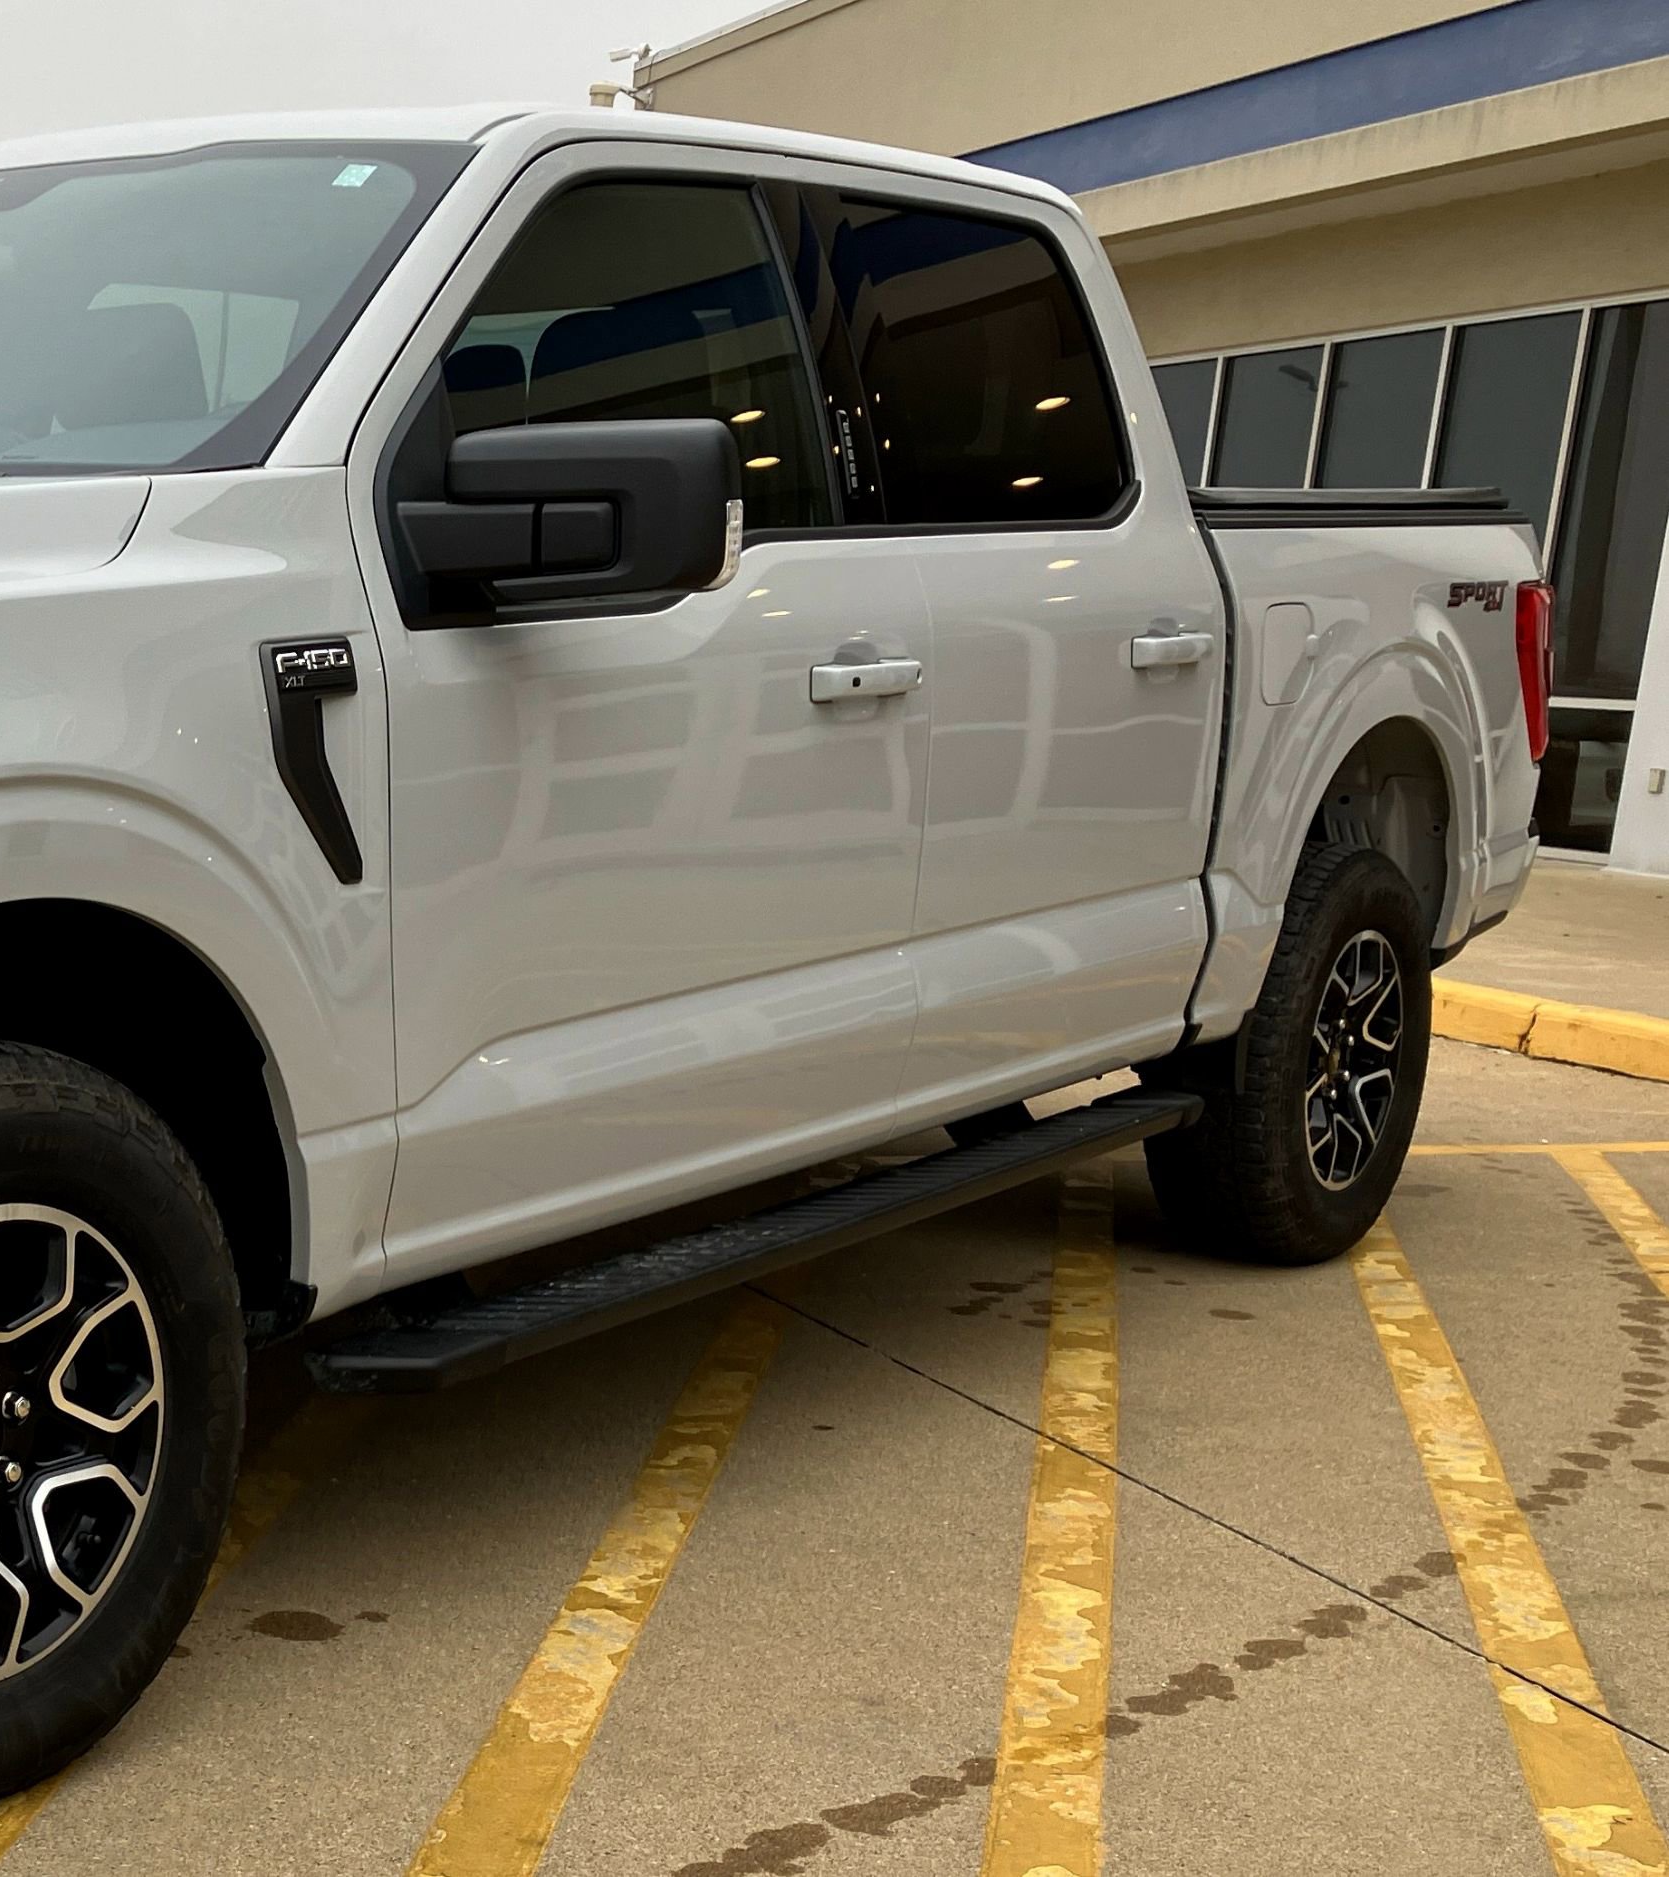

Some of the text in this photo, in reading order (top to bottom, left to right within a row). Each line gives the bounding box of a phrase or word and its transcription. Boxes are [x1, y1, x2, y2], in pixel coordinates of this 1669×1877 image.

[1447, 580, 1509, 611] SPORT
[276, 648, 351, 673] F-150
[284, 675, 306, 688] XLT
